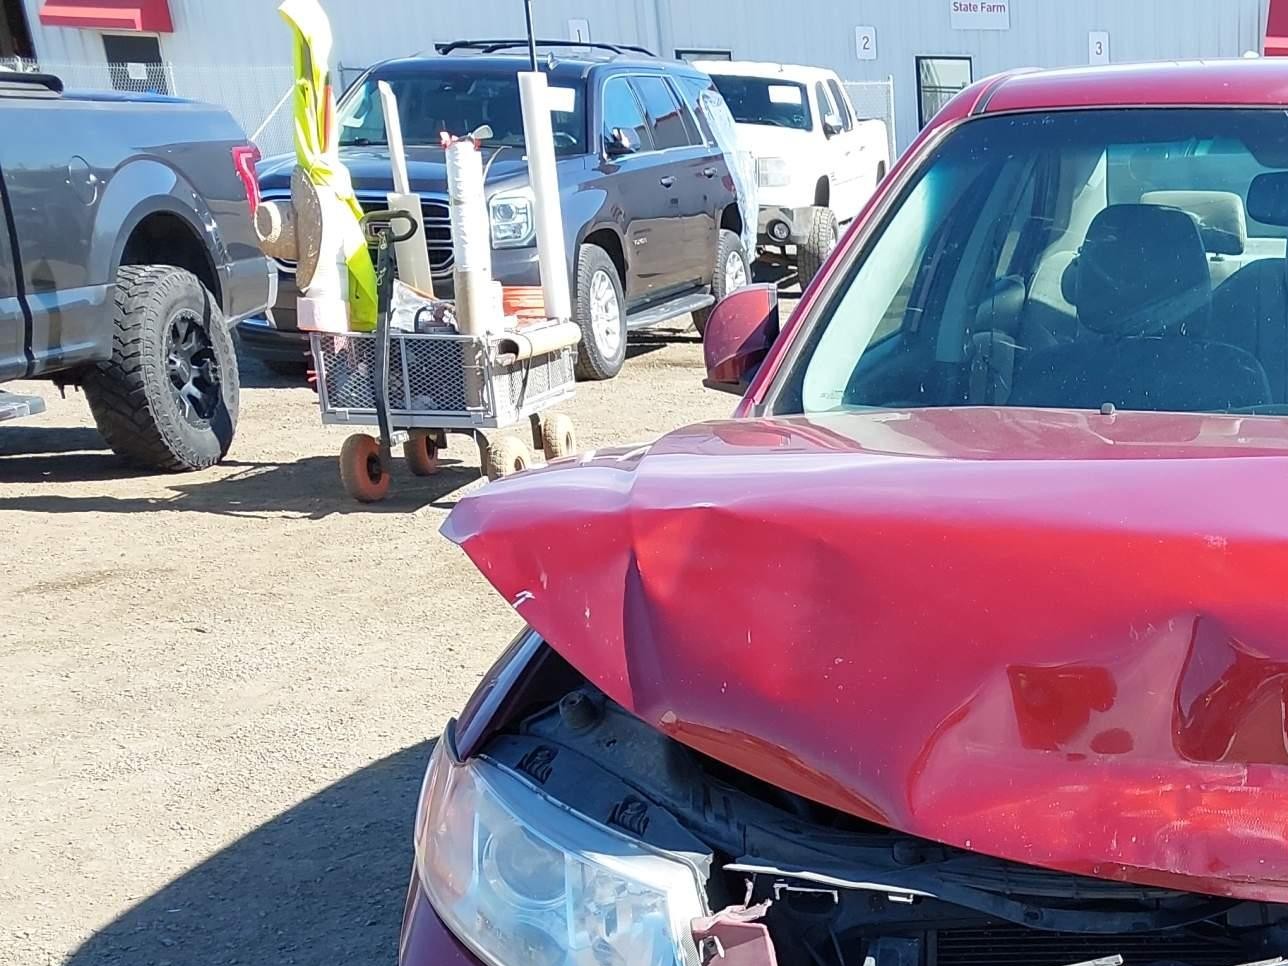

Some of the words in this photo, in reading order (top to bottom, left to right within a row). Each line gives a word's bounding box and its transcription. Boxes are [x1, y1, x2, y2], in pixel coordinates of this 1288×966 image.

[953, 1, 978, 12] State
[981, 2, 1006, 13] Farm
[862, 36, 870, 50] 2
[1095, 41, 1103, 55] 3
